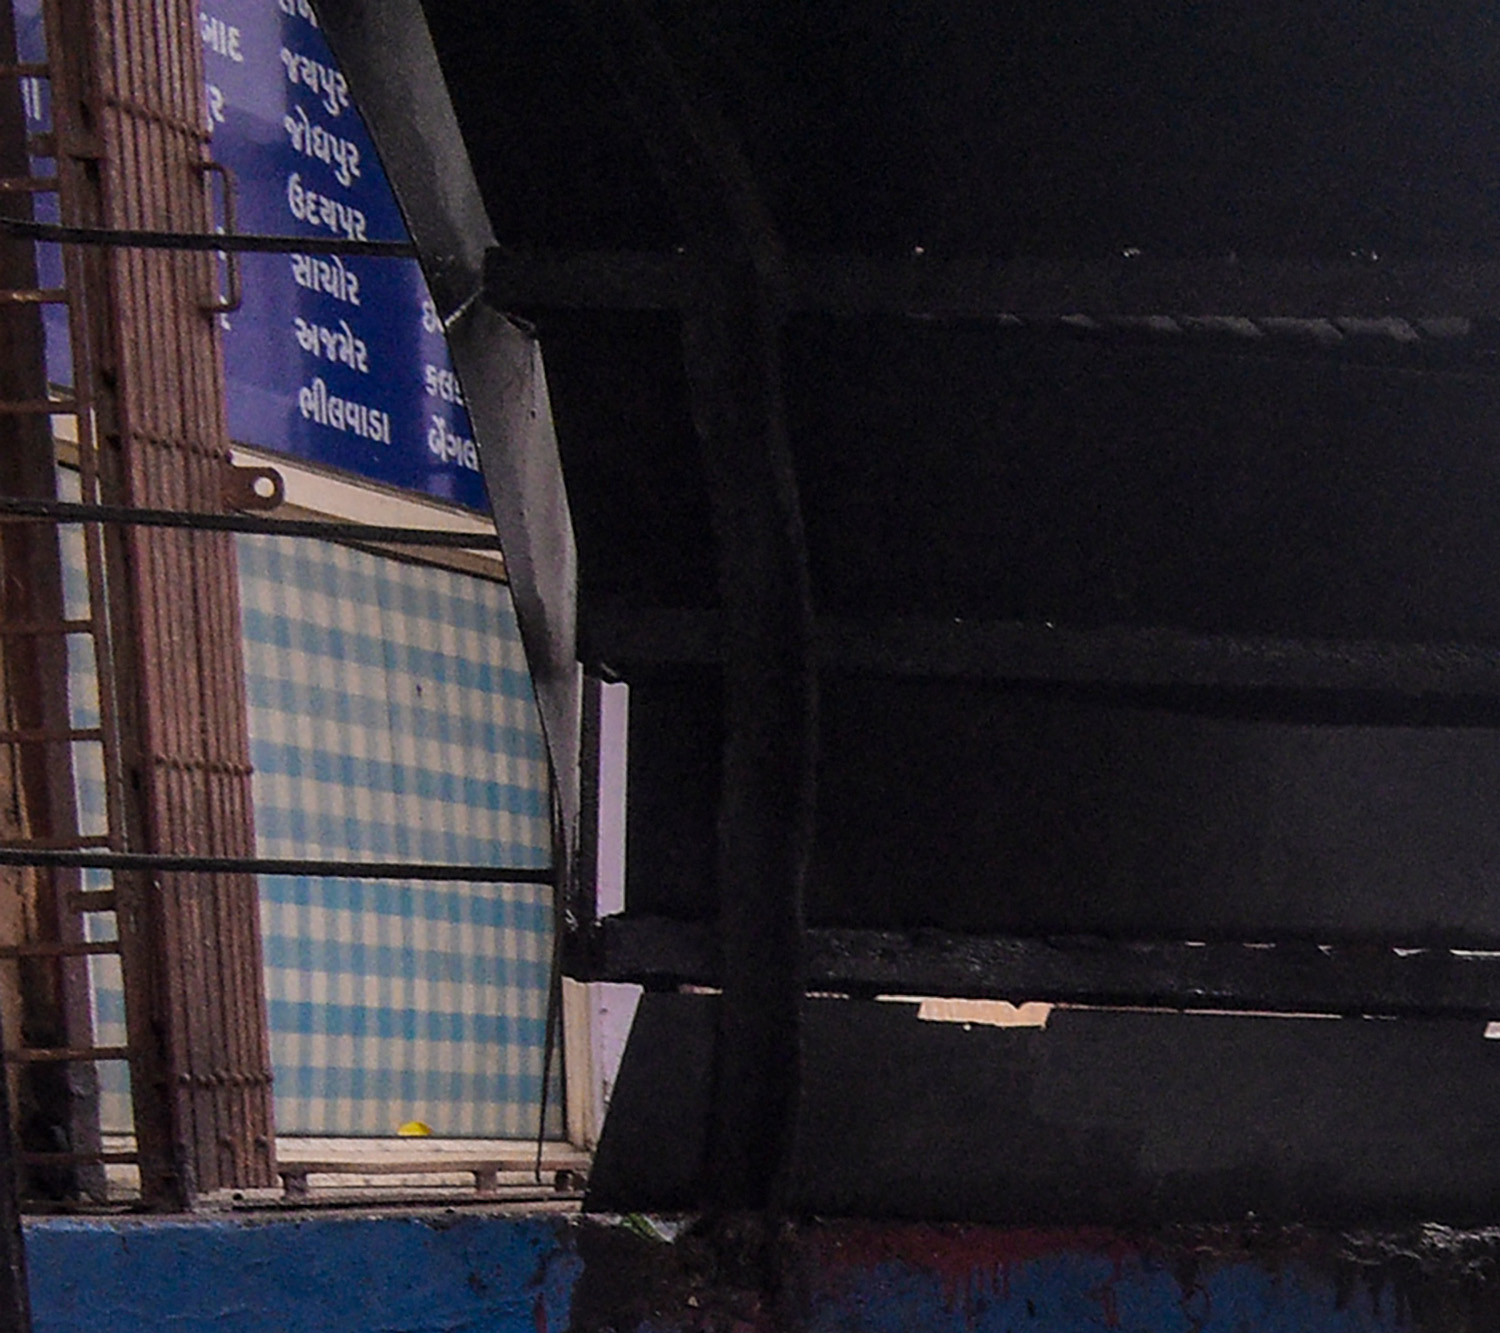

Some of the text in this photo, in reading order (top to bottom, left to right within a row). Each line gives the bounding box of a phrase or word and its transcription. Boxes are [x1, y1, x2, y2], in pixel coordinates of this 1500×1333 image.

[280, 47, 349, 117] જયપુર
[283, 104, 360, 187] જોધપુર
[291, 254, 360, 306] સાચોર
[294, 316, 369, 373] અજમેર
[299, 377, 391, 446] ભીલવાડા
